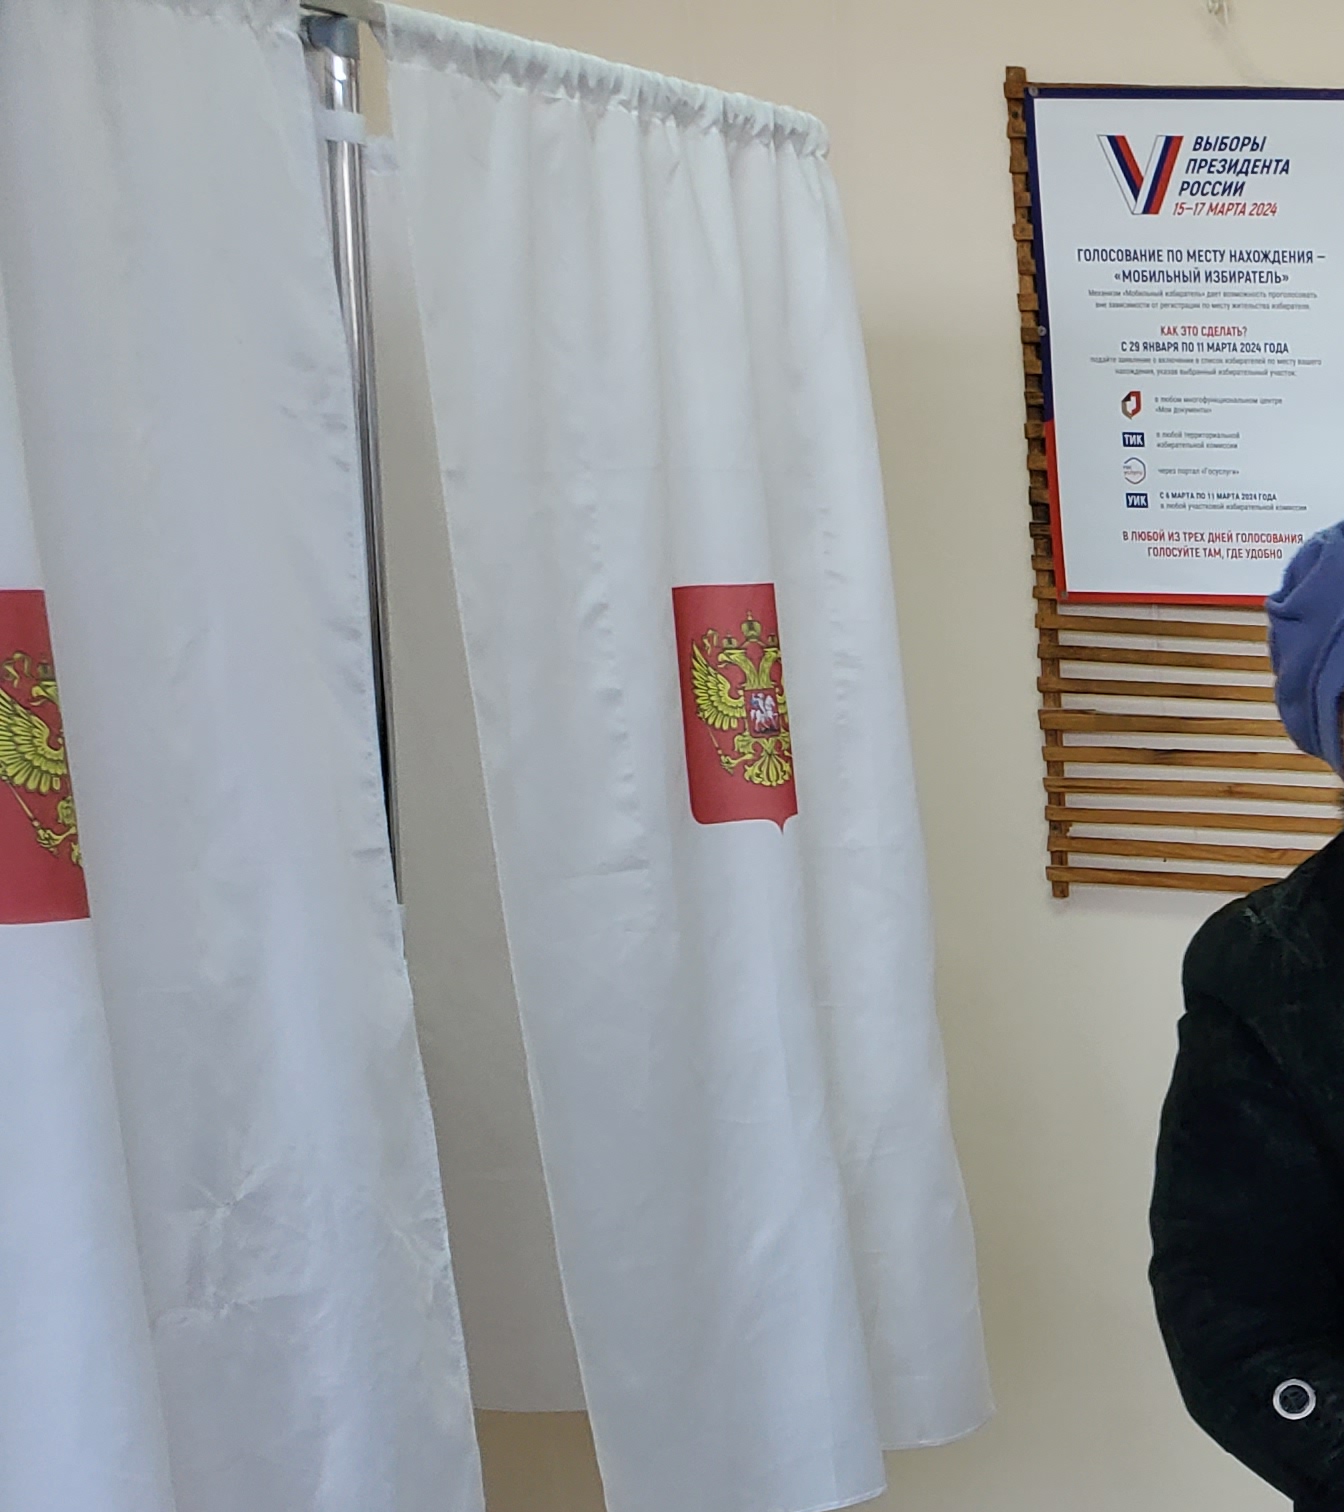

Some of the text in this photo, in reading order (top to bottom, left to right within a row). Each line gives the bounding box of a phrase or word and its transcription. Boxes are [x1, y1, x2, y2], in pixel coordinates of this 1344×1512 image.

[1193, 136, 1266, 152] ВЫБОРЫ
[1185, 159, 1289, 176] ПРЕЗИДЕНТА
[1179, 181, 1245, 196] РОССИИ
[1205, 202, 1246, 216] МАРТА
[1249, 203, 1277, 216] 2024
[1078, 249, 1163, 262] ГОЛОСОВАНИЕ
[1167, 250, 1183, 262] ПО
[1187, 250, 1225, 262] МЕСТУ
[1230, 250, 1313, 264] НАХОЖДЕНИЯ
[1115, 267, 1288, 283] «МОБИЛЬНЫЙ ИЗБИРАТЕЛЬ»
[1161, 326, 1247, 337] КАК ЭТО СДЕЛАТЬ?
[1121, 341, 1288, 354] С 29 ЯНВАРЯ ПО 11 МАРТА 2024 ГОДА
[1124, 434, 1143, 445] ТИК
[1128, 496, 1147, 506] УИК
[1257, 493, 1277, 501] ГОДА
[1123, 530, 1304, 545] В ЛЮБОЙ ИЗ ТРЕХ ДНЕЙ ГОЛОСОВАНИЯ
[1148, 546, 1282, 559] ГОЛОСУЙТЕ ТАМ, ГДЕ УДОБНО
